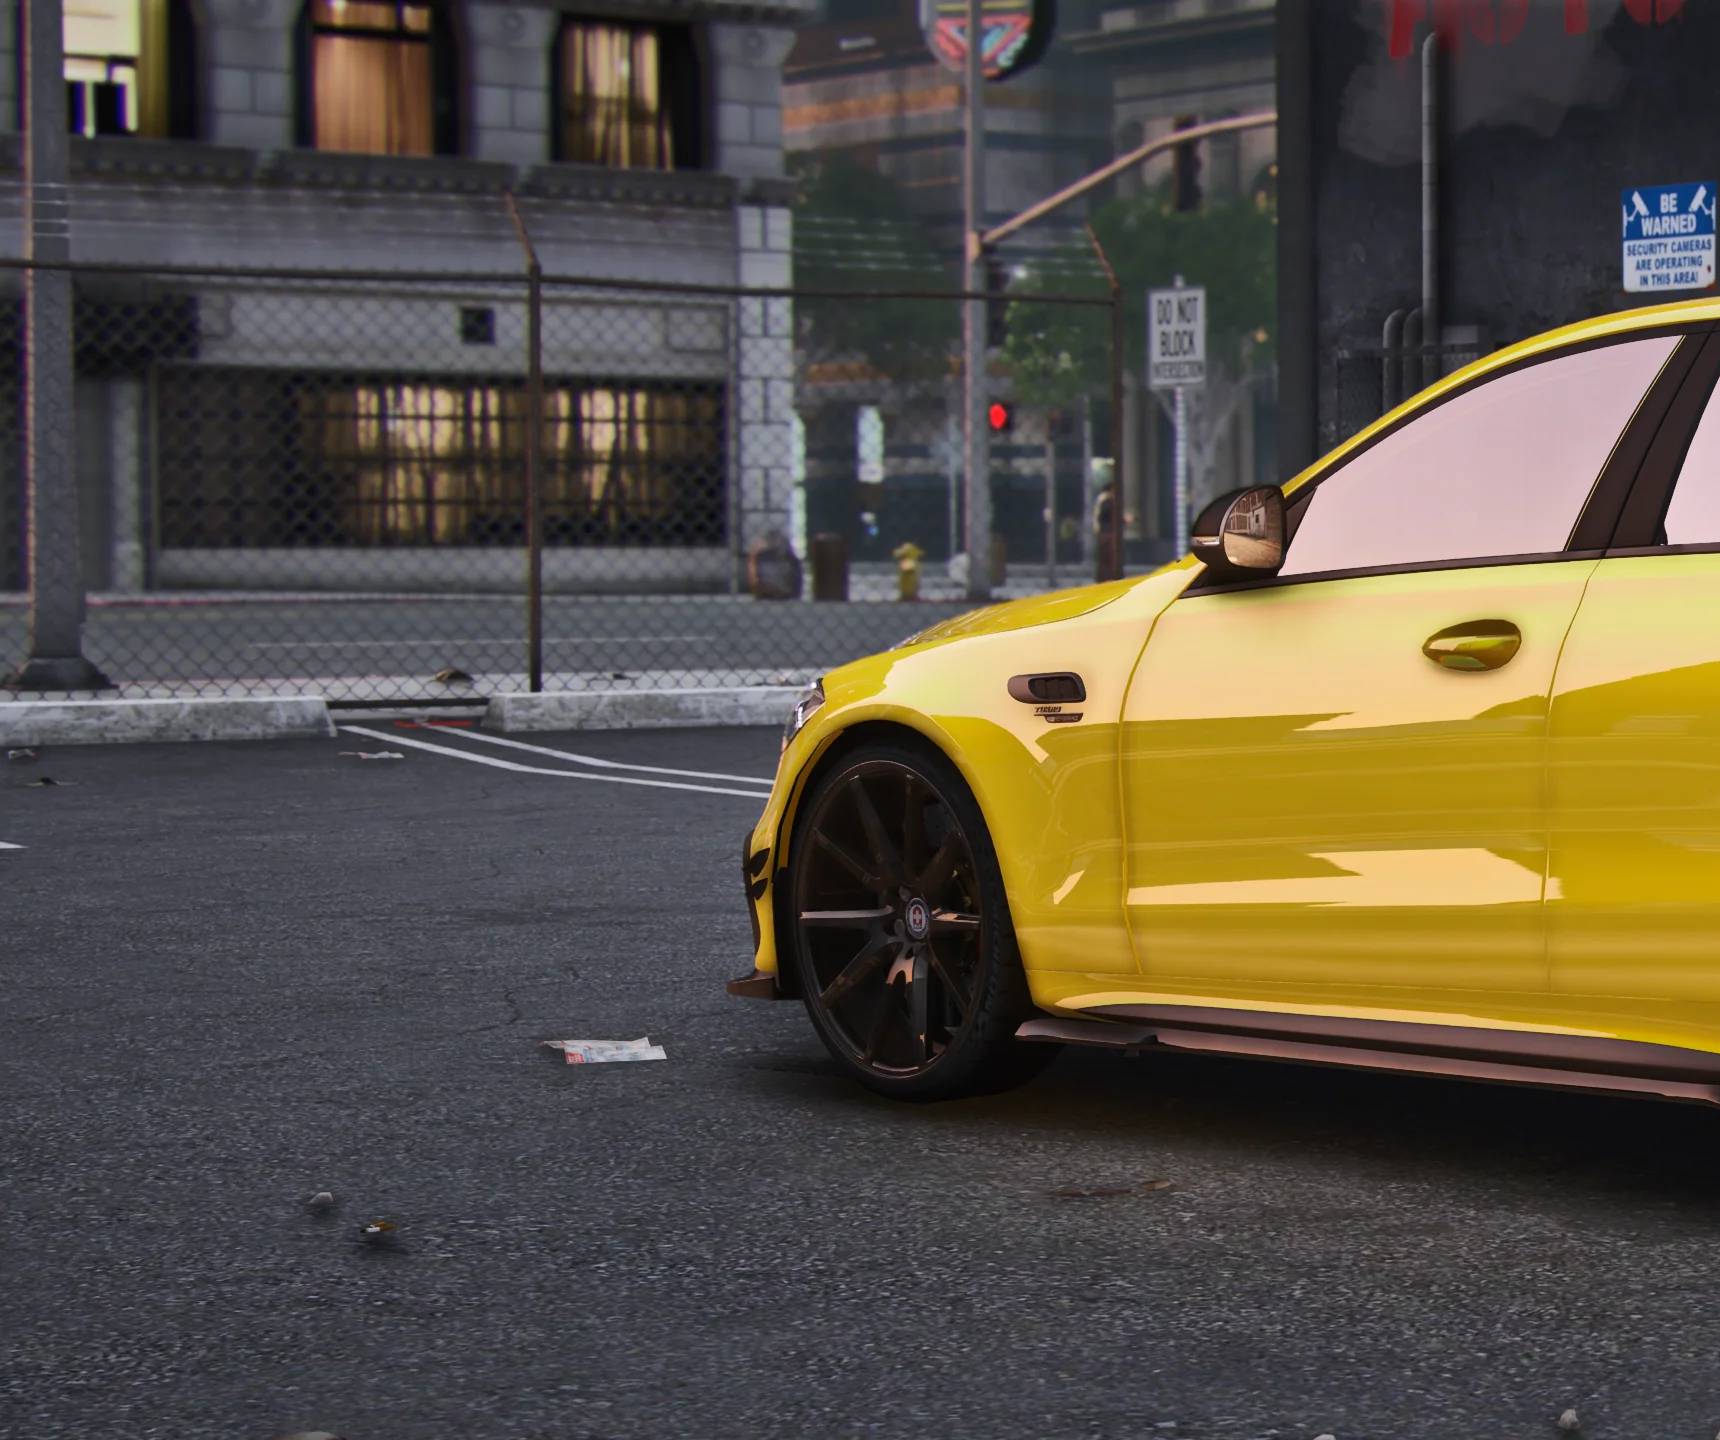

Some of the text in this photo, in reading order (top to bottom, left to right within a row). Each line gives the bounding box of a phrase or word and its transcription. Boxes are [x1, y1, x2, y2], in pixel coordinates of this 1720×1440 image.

[1660, 193, 1678, 214] BE
[1641, 214, 1696, 236] WARNED
[1626, 238, 1712, 257] SECURITY CAMERAS
[1635, 255, 1703, 271] ARE OPERATING
[1639, 271, 1699, 286] IN THIS AREA!
[1157, 296, 1198, 326] DO NOT
[1160, 330, 1196, 358] BLOCK
